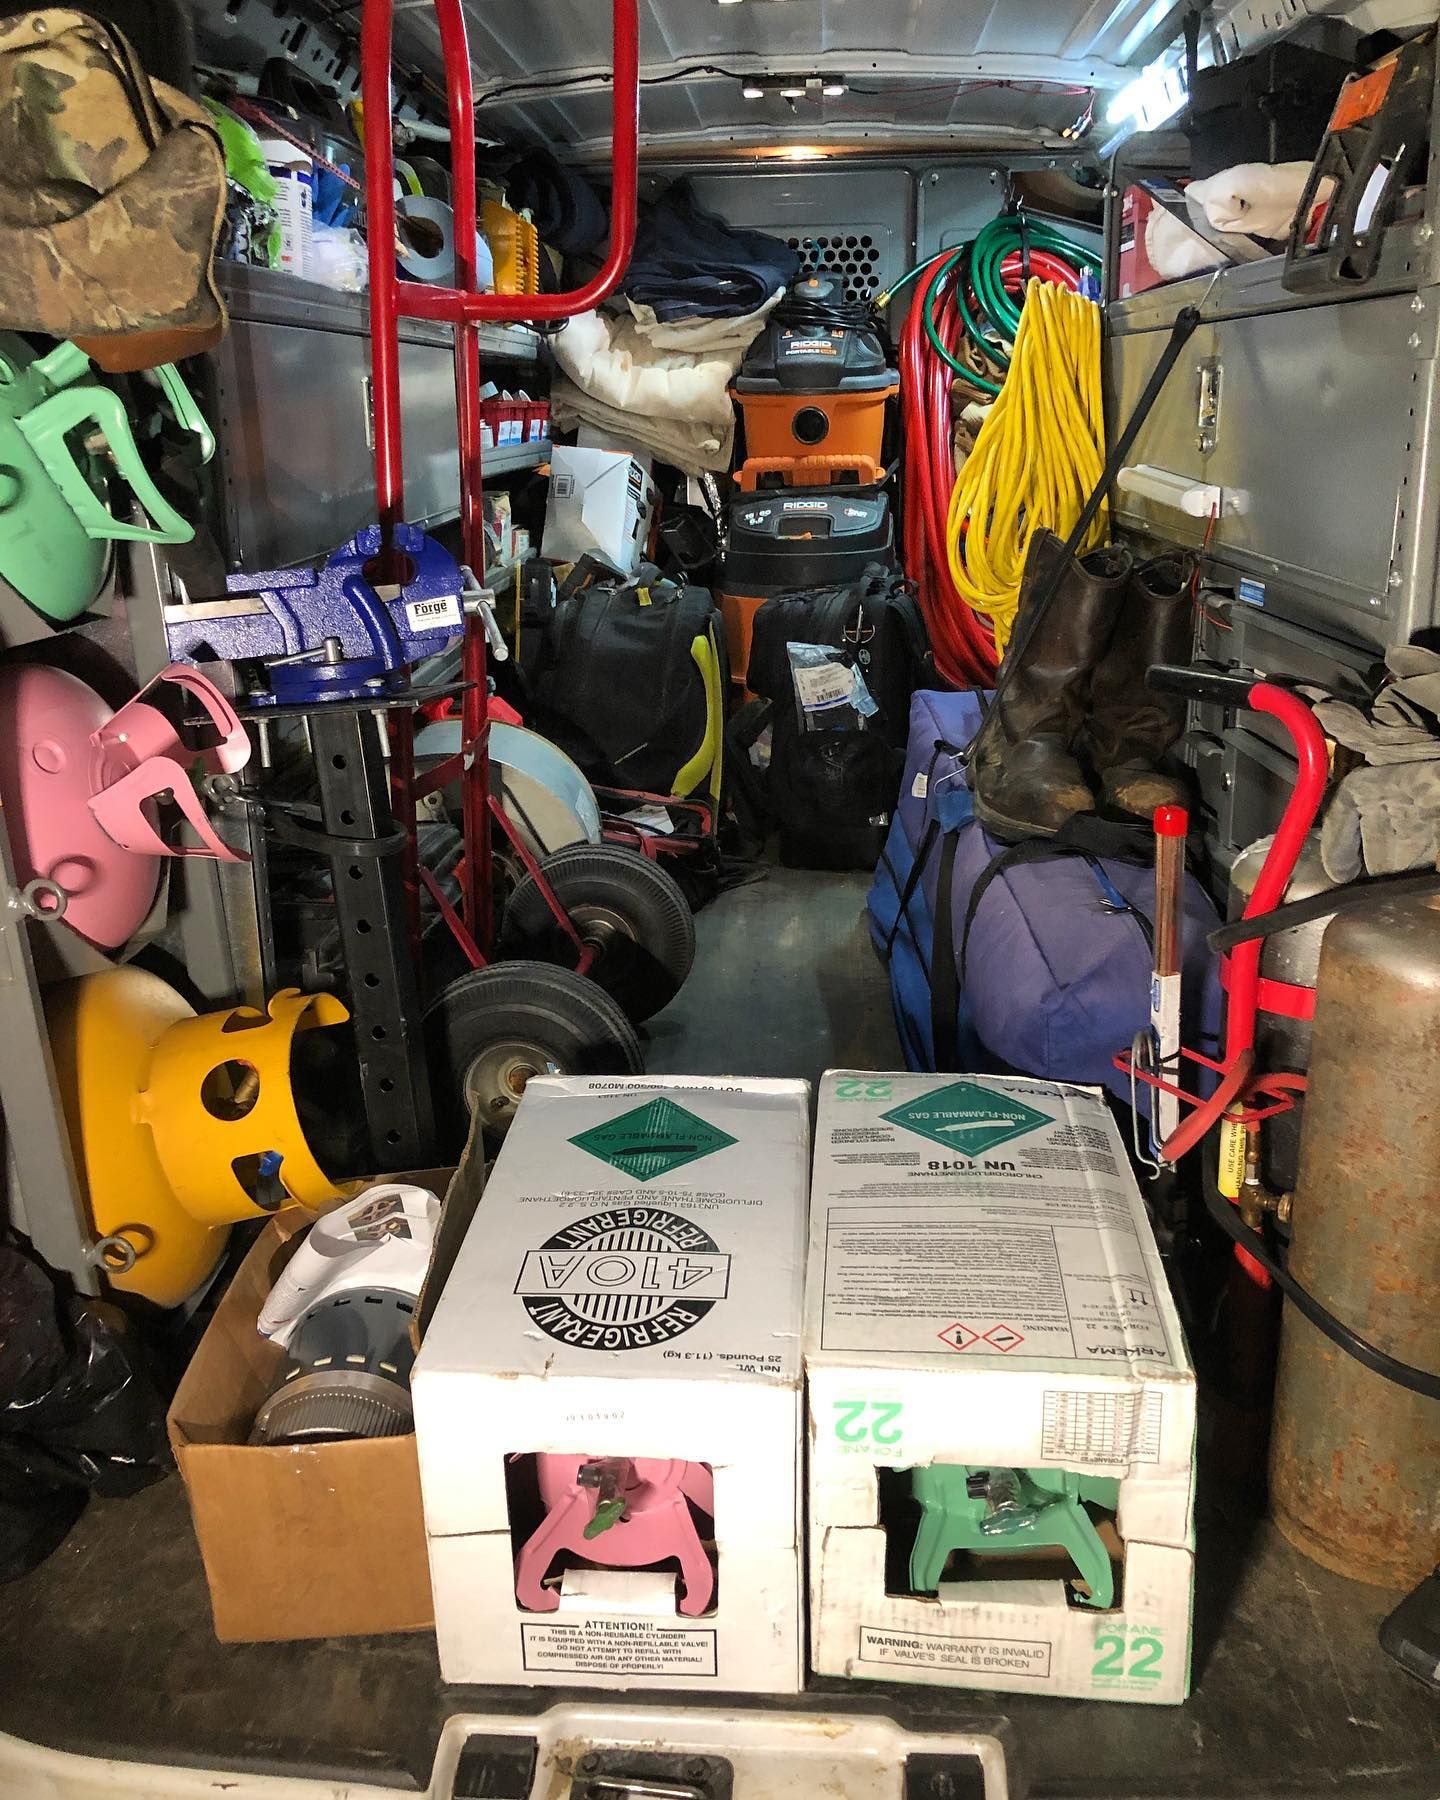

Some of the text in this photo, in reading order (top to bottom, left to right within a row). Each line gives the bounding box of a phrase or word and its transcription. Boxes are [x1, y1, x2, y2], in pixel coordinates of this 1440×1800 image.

[790, 341, 832, 349] RIDGID
[783, 502, 828, 510] RIDGID
[836, 1080, 893, 1098] 22
[932, 1110, 1026, 1121] NON-FLAMMABLE
[1227, 1121, 1238, 1174] USE CARE WHE
[927, 1161, 1015, 1171] UN 1018
[907, 1171, 1043, 1179] CHLORODIFLUOROMETHANE
[519, 1194, 634, 1203] PENTAFLUOROETHANE
[633, 1200, 678, 1208] Liquefied
[660, 1195, 763, 1206] DIFLUOROMETHANE
[680, 1202, 720, 1210] UN3163
[555, 1208, 708, 1249] REFRIGERANT
[538, 1255, 713, 1290] 410A
[528, 1302, 699, 1349] REFRIGERANT
[1022, 1324, 1069, 1333] WARNING
[662, 1350, 782, 1363] 25 Pounds. (11.3 kg)
[1086, 1346, 1166, 1358] ARKEMA
[735, 1364, 781, 1373] Net Wt.
[832, 1401, 903, 1444] 22
[584, 1620, 654, 1632] ATTENTION!!
[548, 1636, 585, 1644] EQUIPPED
[585, 1631, 644, 1639] NON-REUSABLE
[646, 1632, 686, 1640] CYLINDER!
[587, 1646, 622, 1654] ATTEMPT
[866, 1635, 1045, 1659] WARNING: WARRANTY IS INVALID
[537, 1651, 589, 1660] COMPRESSED
[879, 1647, 1030, 1669] IF VALVE'S SEAL IS BROKEN
[1091, 1634, 1164, 1679] 22
